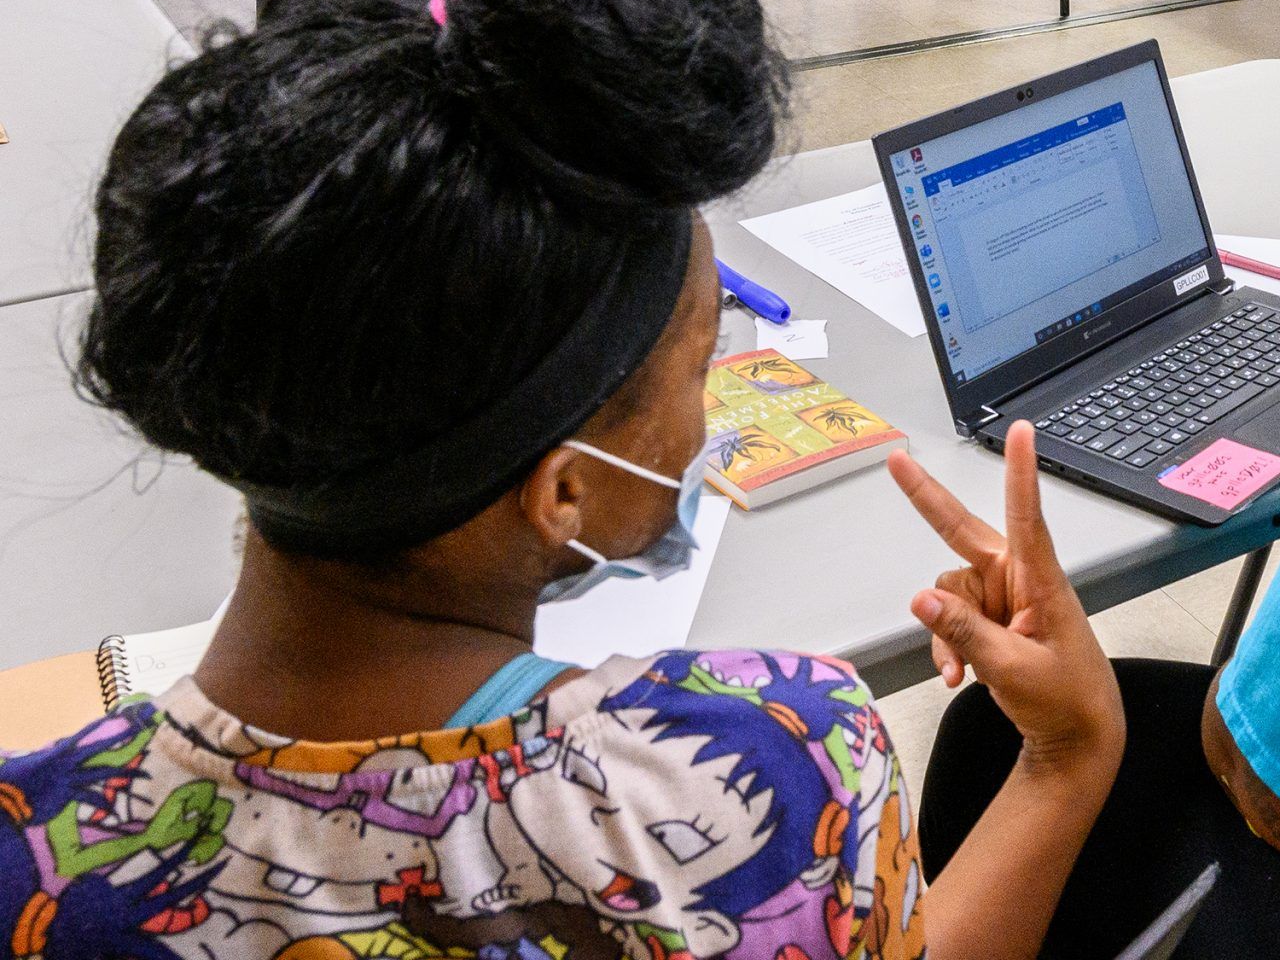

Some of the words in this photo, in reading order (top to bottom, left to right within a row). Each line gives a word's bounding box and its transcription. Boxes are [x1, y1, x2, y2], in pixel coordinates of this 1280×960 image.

[1176, 269, 1207, 291] GPLLC001
[780, 397, 818, 411] THE
[134, 654, 166, 673] Do
